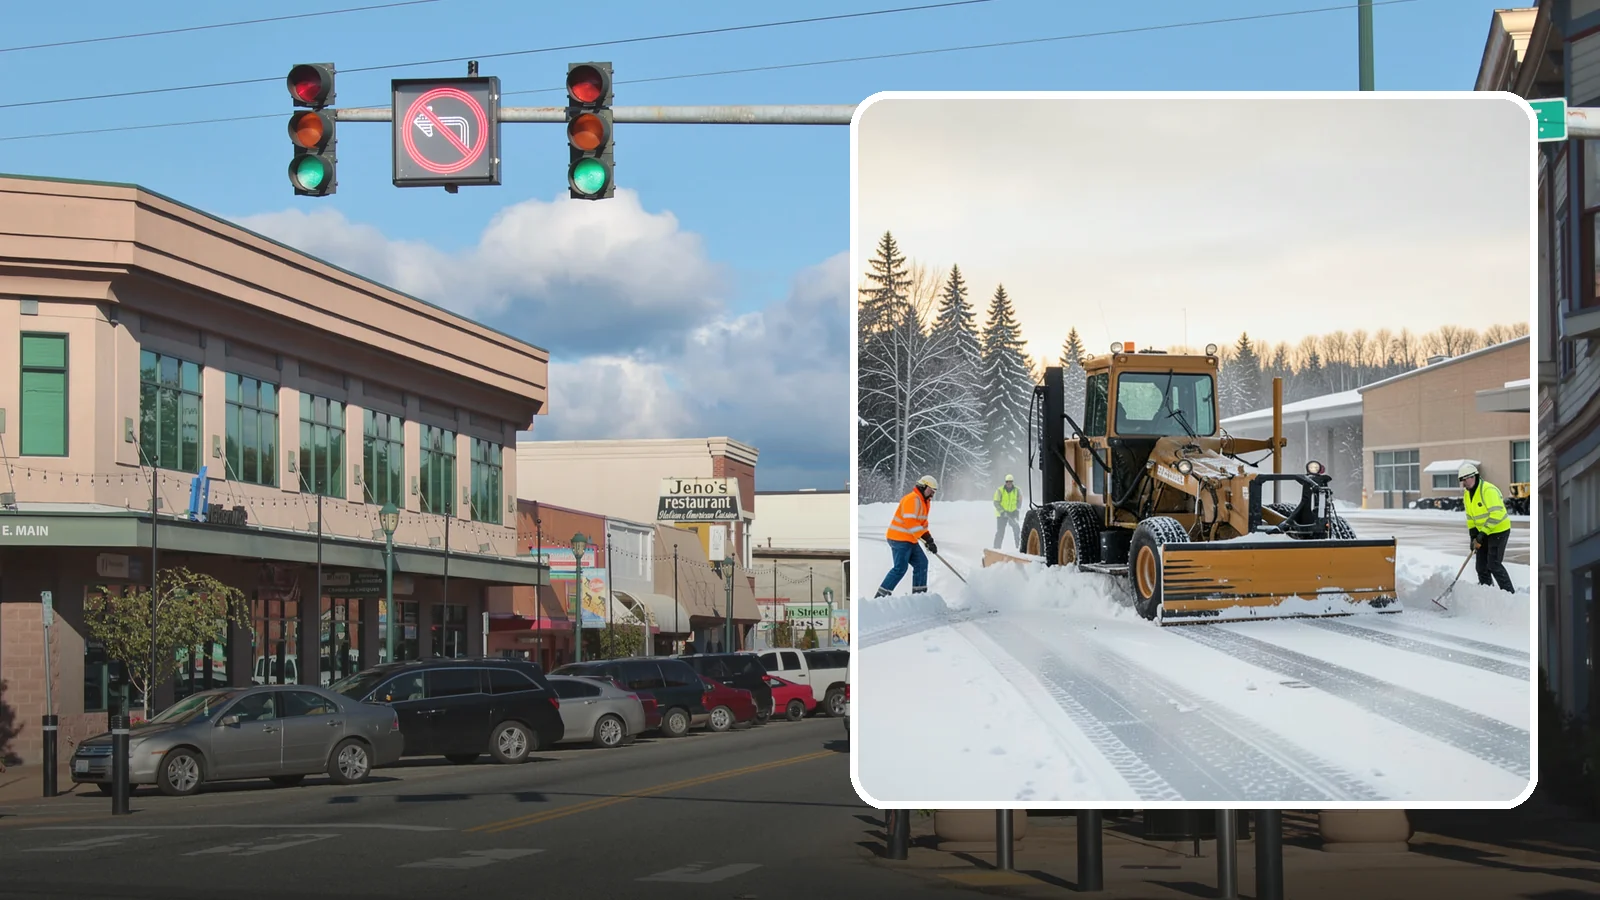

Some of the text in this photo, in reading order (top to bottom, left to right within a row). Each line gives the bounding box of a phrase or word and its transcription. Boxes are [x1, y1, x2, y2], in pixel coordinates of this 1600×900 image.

[669, 480, 728, 494] Jeno's
[665, 496, 731, 509] restaurant
[658, 509, 681, 519] Italian
[686, 509, 714, 519] American
[715, 509, 738, 519] Cuisine
[2, 525, 49, 536] E. MAIN
[797, 607, 828, 617] Street
